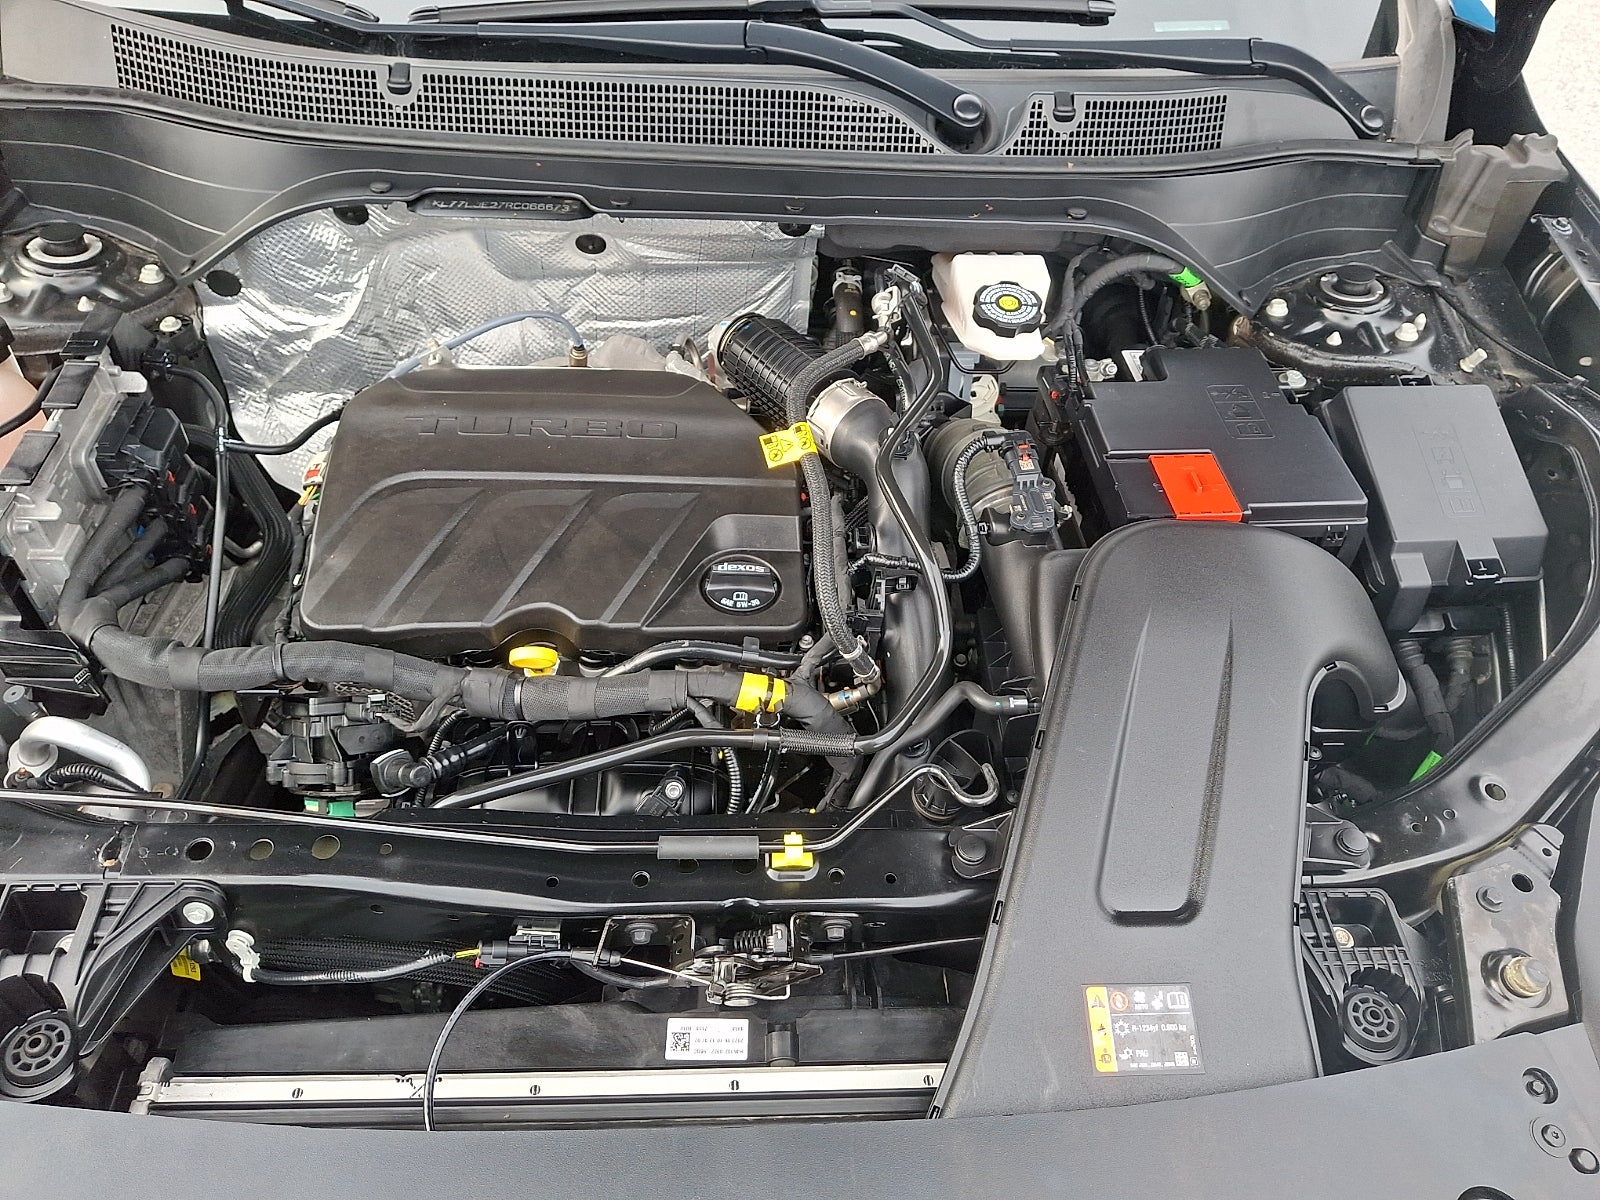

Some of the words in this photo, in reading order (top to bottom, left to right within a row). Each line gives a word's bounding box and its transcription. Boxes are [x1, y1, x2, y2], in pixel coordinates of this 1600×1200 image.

[404, 416, 678, 441] TURBO
[717, 562, 766, 573] dexos
[720, 597, 735, 607] SAE
[1179, 1023, 1187, 1032] kg
[1135, 1049, 1149, 1058] PAG
